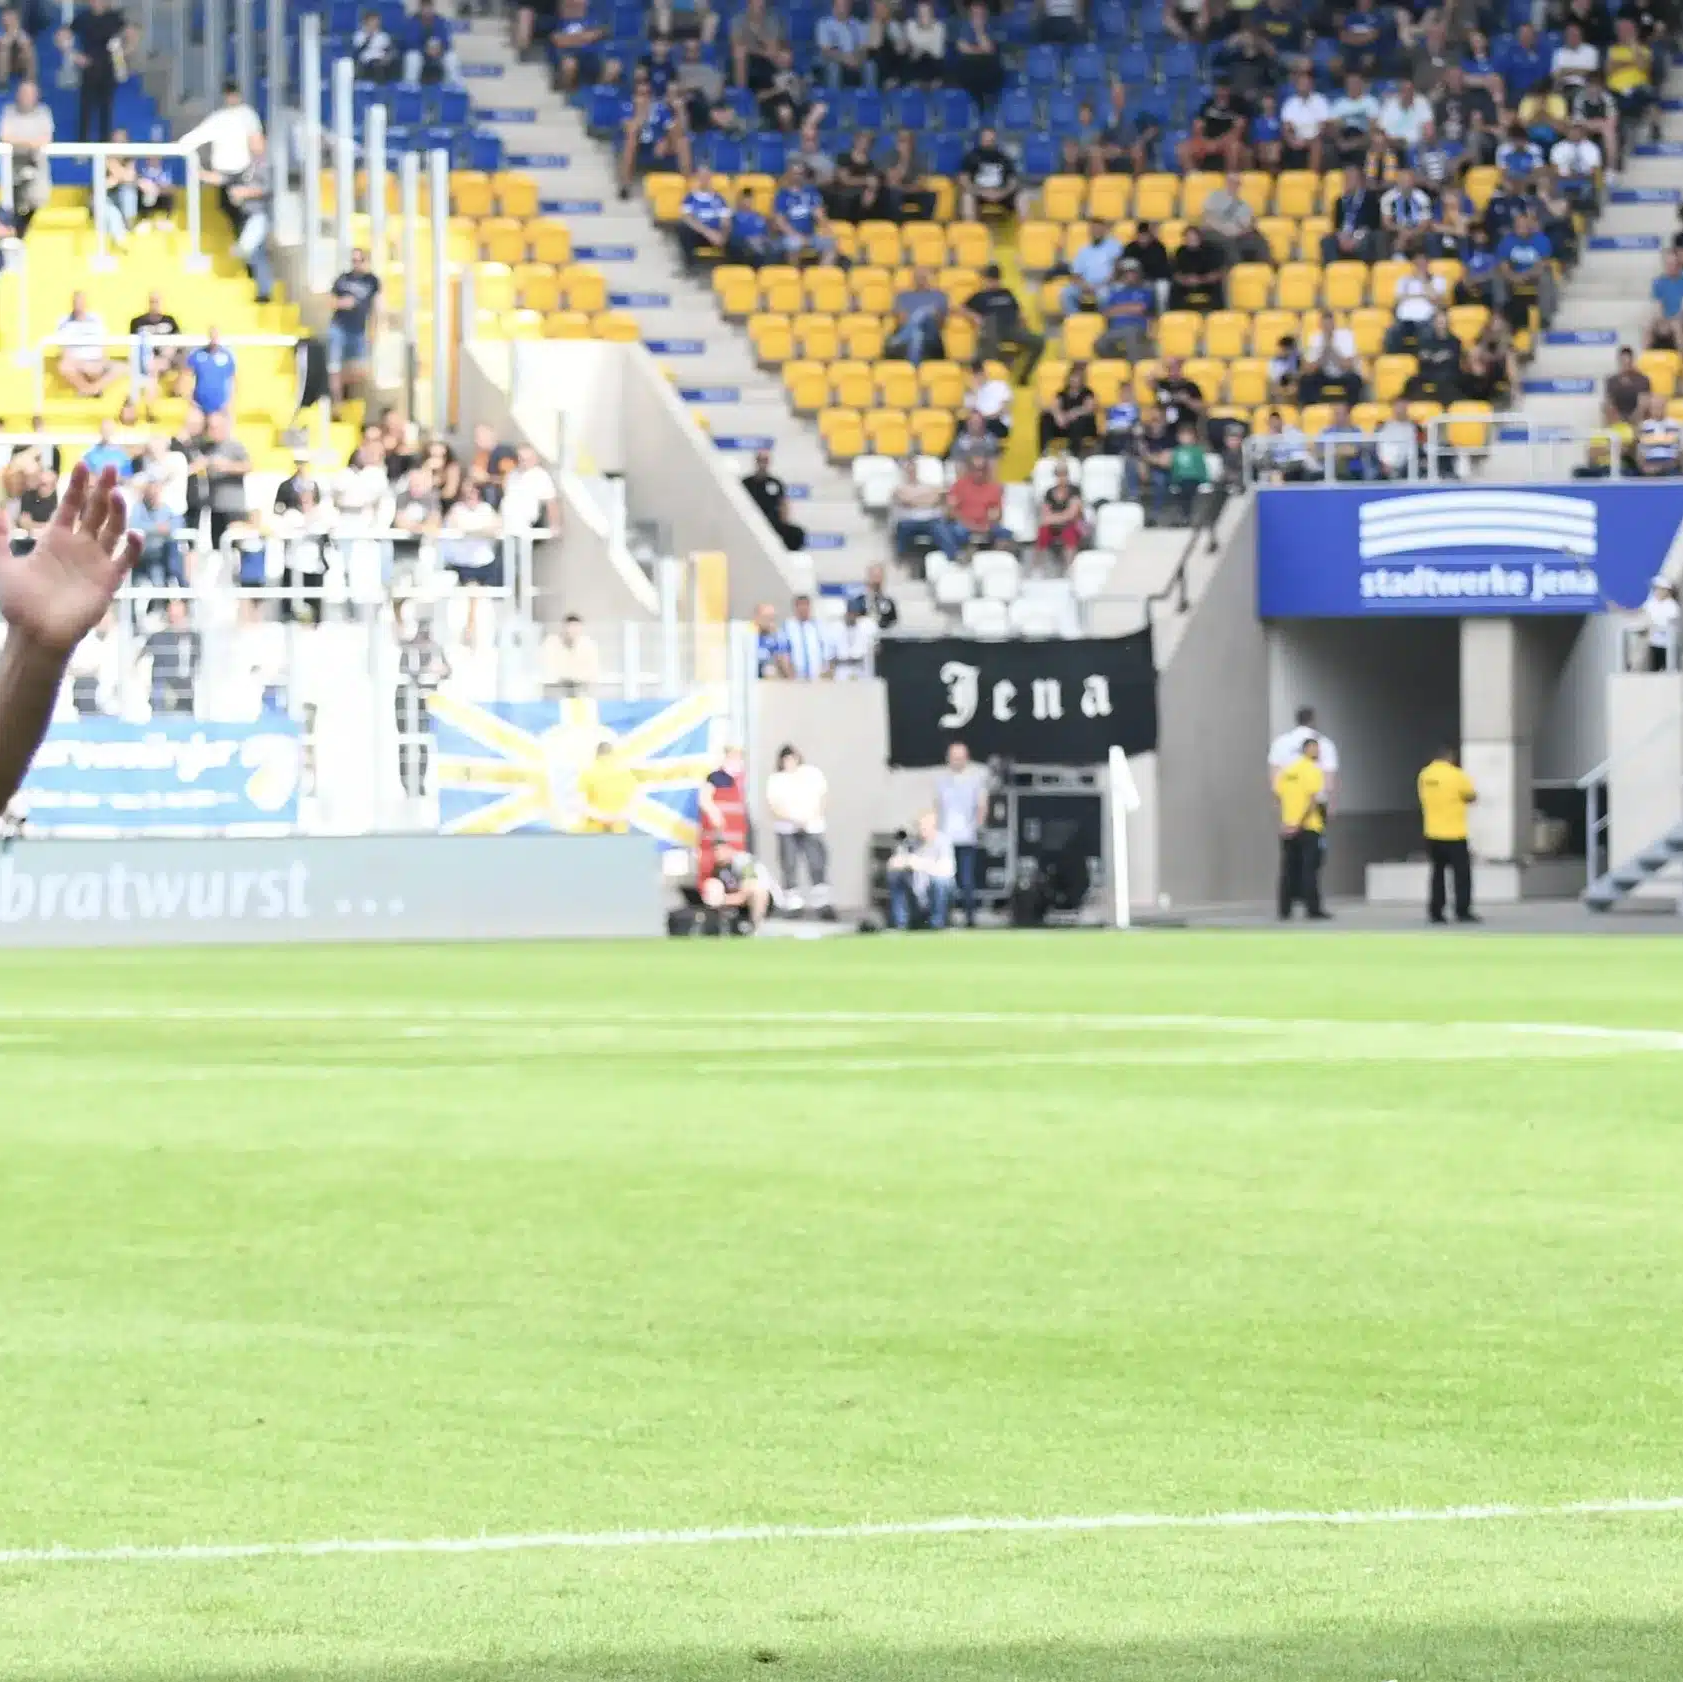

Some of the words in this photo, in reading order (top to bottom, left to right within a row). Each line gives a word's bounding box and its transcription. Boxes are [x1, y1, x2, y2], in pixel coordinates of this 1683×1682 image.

[1360, 563, 1528, 598] stadtwerke
[1530, 561, 1599, 601] jena
[938, 661, 1114, 729] Jena
